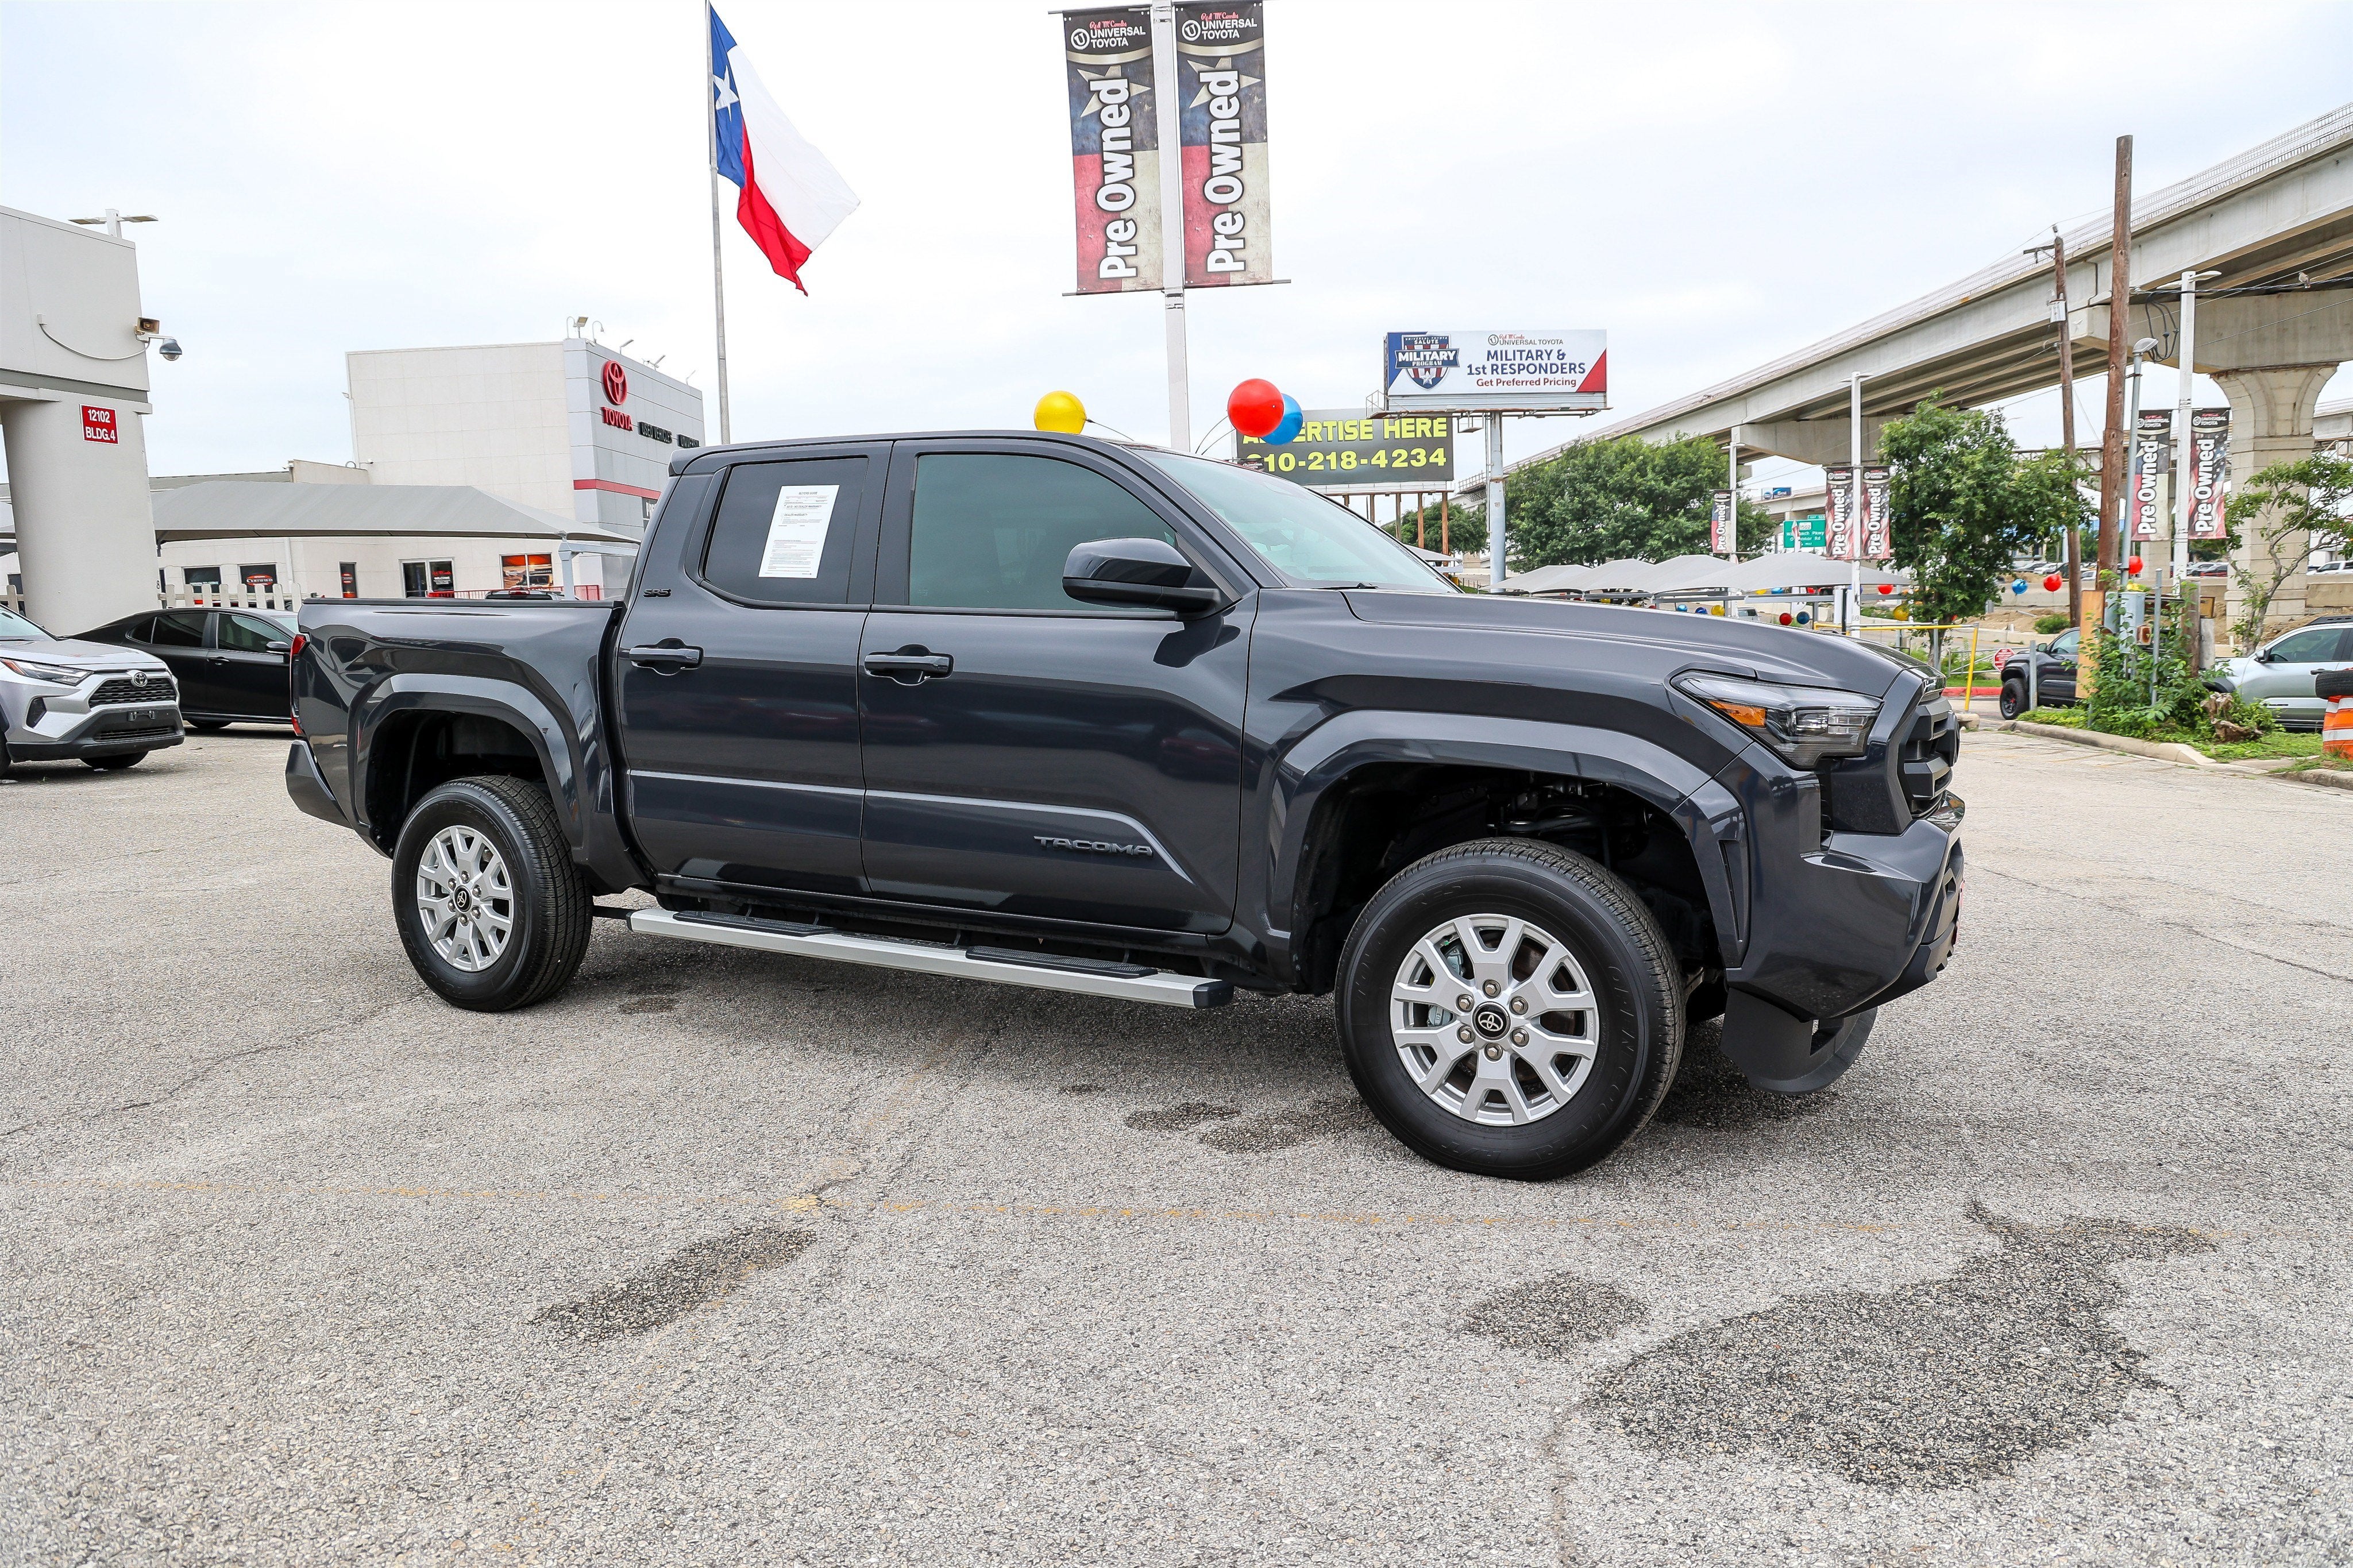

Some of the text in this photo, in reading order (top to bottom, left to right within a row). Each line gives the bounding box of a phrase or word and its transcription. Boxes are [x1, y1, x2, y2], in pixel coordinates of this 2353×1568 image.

[1090, 26, 1146, 38] UNIVERSAL
[1202, 18, 1257, 30] UNIVERSAL
[1202, 29, 1240, 40] TOYOTA
[1091, 37, 1128, 48] TOYOTA
[1089, 78, 1137, 279] Pre Owned
[1199, 70, 1246, 272] Pre Owned
[1398, 350, 1456, 362] MILITARY
[1487, 348, 1567, 361] MILITARY &
[1467, 362, 1586, 375] 1st RESPONDERS
[1476, 377, 1576, 388] Get Preferred Pricing
[87, 409, 111, 423] 12102
[600, 406, 633, 431] TOYOTA
[1243, 418, 1448, 445] ERTISE HERE
[1247, 447, 1447, 472] 10-218-4234
[2136, 440, 2159, 502] Owned
[2194, 438, 2215, 500] Owned
[1715, 504, 1726, 535] Owned
[1831, 488, 1845, 532] Owned
[1868, 488, 1881, 532] Owned
[2137, 504, 2157, 534] Pre
[2194, 502, 2214, 532] Pre
[1716, 535, 1727, 551] Pre
[1832, 533, 1846, 555] Pre
[1868, 532, 1881, 555] Pre
[1033, 835, 1154, 858] TACOMA
